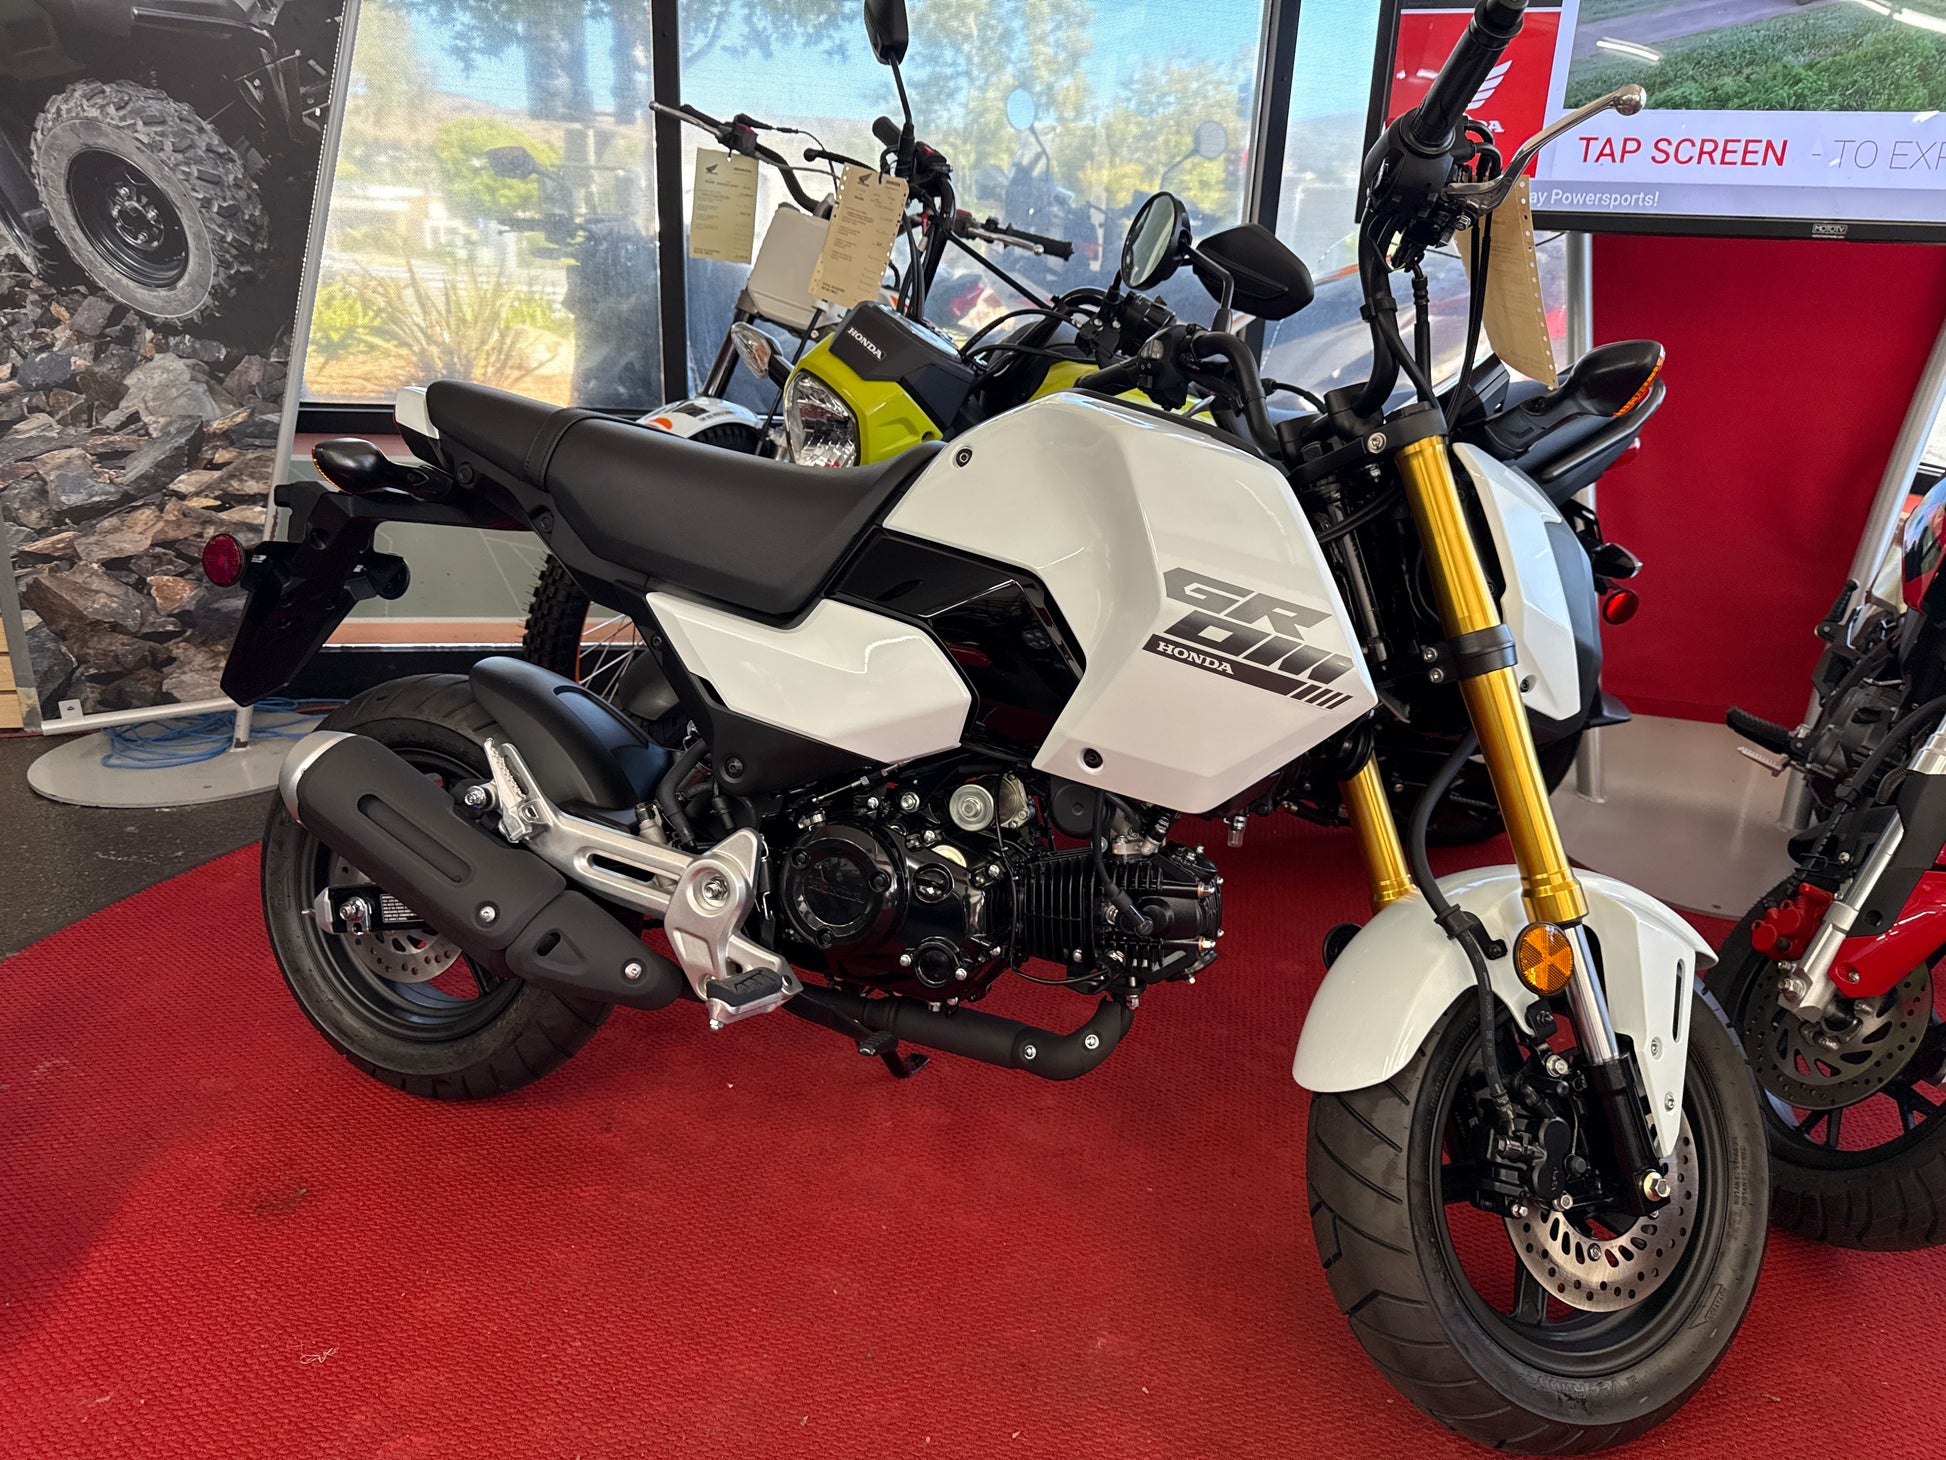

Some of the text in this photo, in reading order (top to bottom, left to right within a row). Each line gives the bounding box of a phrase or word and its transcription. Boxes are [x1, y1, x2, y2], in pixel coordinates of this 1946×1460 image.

[1578, 136, 1642, 163] TAP
[1650, 137, 1788, 167] SCREEN
[1834, 140, 1878, 168] TO
[1550, 189, 1659, 209] Powersports!
[847, 327, 882, 360] HONDA
[1156, 641, 1234, 675] HONDA
